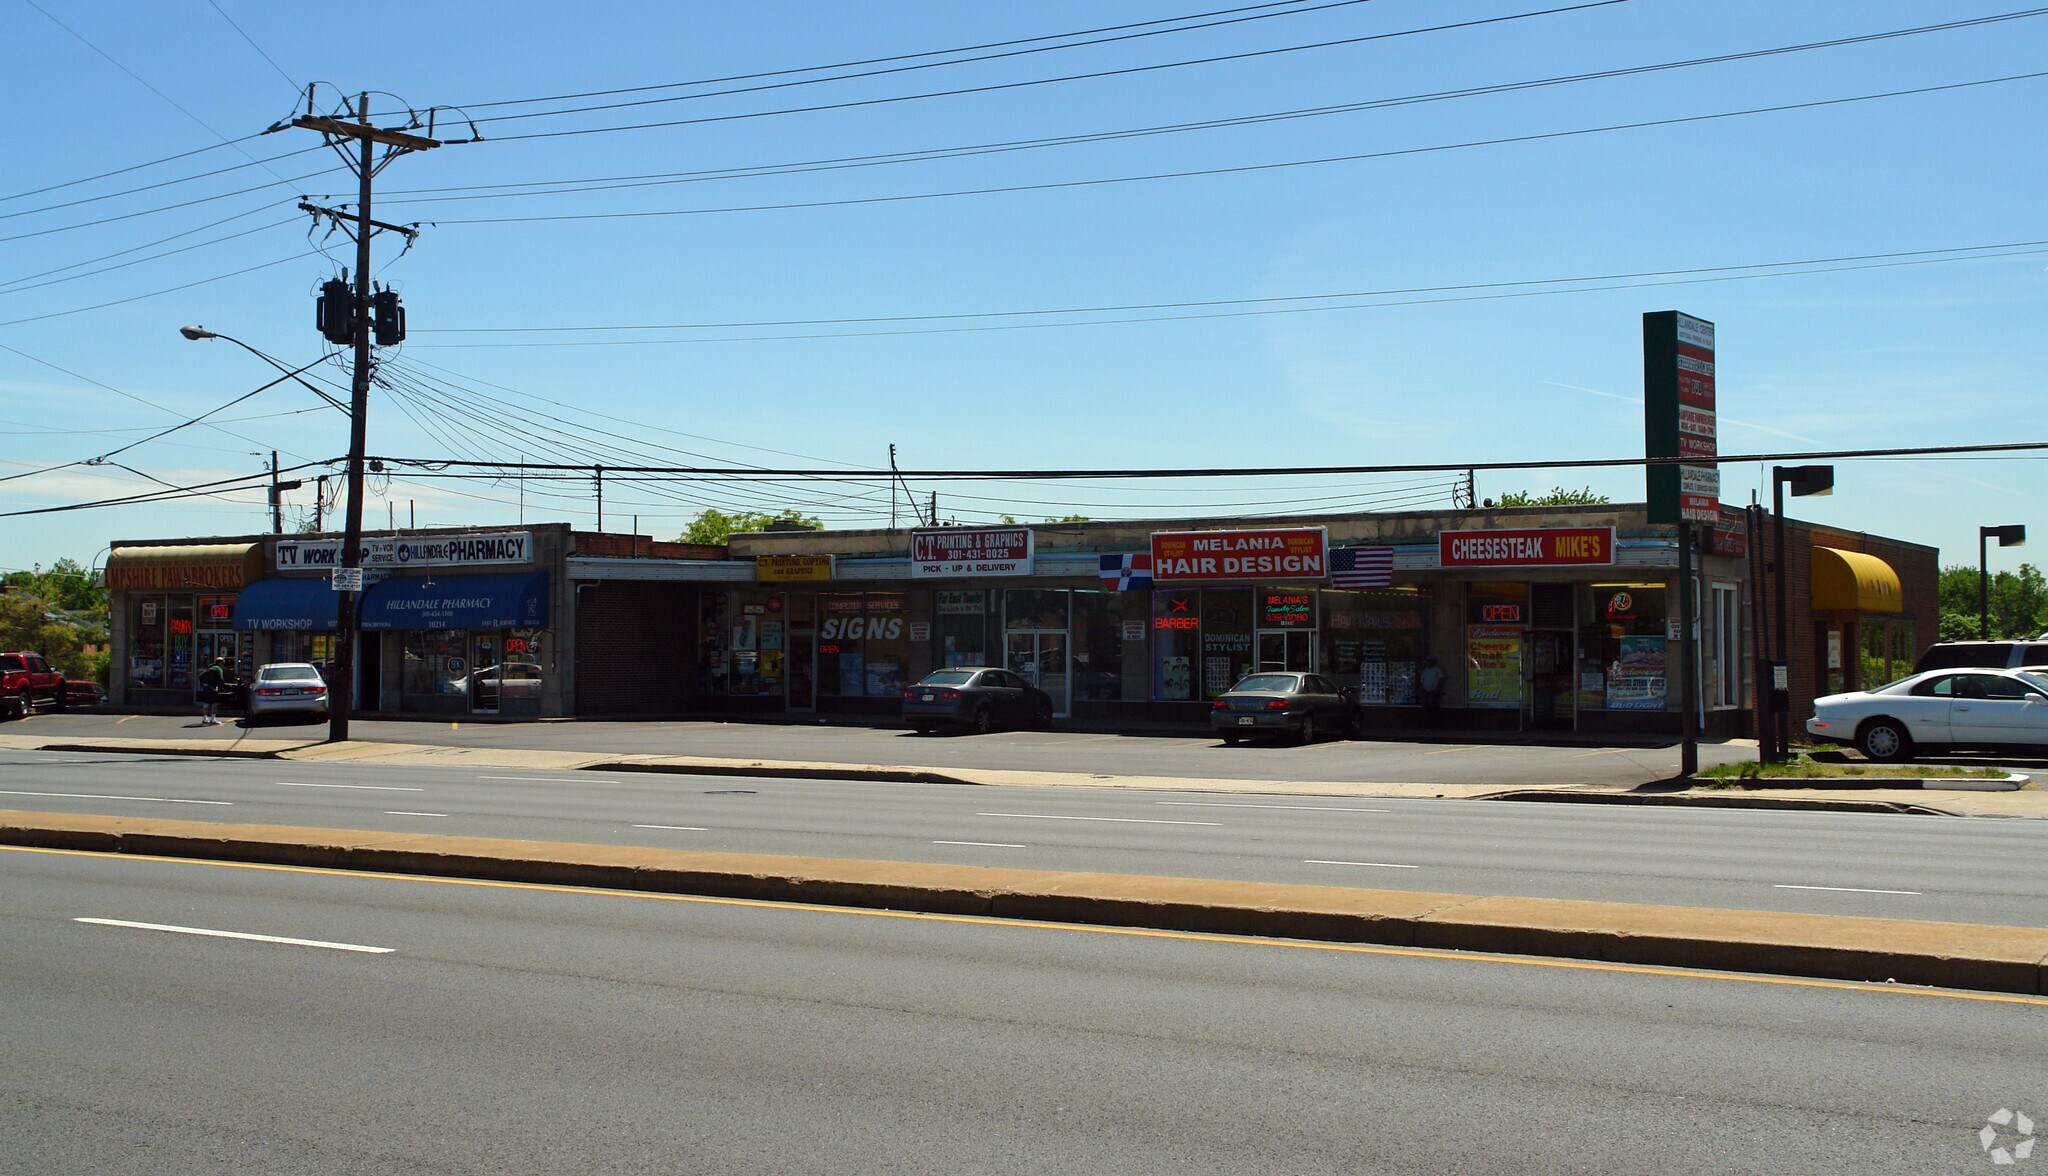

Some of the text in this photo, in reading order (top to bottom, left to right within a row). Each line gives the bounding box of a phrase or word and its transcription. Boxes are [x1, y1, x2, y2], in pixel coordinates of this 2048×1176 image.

[1681, 507, 1717, 521] HAIR DESIGN
[371, 544, 380, 552] TV
[449, 537, 524, 562] PHARMACY
[915, 532, 1024, 561] C.T. PRINTING & GRAPHICS
[1193, 536, 1285, 552] MELANIA
[1452, 535, 1600, 560] CHEESESTEAK MIKE'S
[278, 545, 298, 564] TV
[303, 548, 337, 564] WORK
[371, 554, 394, 563] SERVICE
[947, 548, 1009, 561] 301-431-0025
[923, 564, 942, 573] PICK
[952, 564, 963, 573] UP
[966, 563, 972, 572] &
[976, 562, 1016, 572] DELIVERY
[1157, 554, 1320, 575] HAIR DESIGN
[161, 564, 242, 589] PAWNBROKERS
[386, 596, 493, 611] HILLANDALE PHARMACY
[867, 600, 900, 610] SERVICES
[1267, 595, 1309, 605] MELANIA'S
[211, 604, 229, 618] OPEN
[1483, 605, 1519, 621] OPEN
[171, 618, 192, 635] PAWN
[247, 618, 313, 630] TV WORKSHOP
[428, 620, 446, 629] 10214
[821, 617, 903, 641] SIGNS
[1155, 617, 1199, 630] BARBER
[174, 634, 188, 648] BUY
[1204, 633, 1251, 643] DOMINICAN
[506, 638, 527, 654] OPEN
[1205, 643, 1250, 652] STYLIST
[1470, 642, 1513, 651] Cheese
[1470, 651, 1503, 660] Steak
[1610, 702, 1632, 710] BUD
